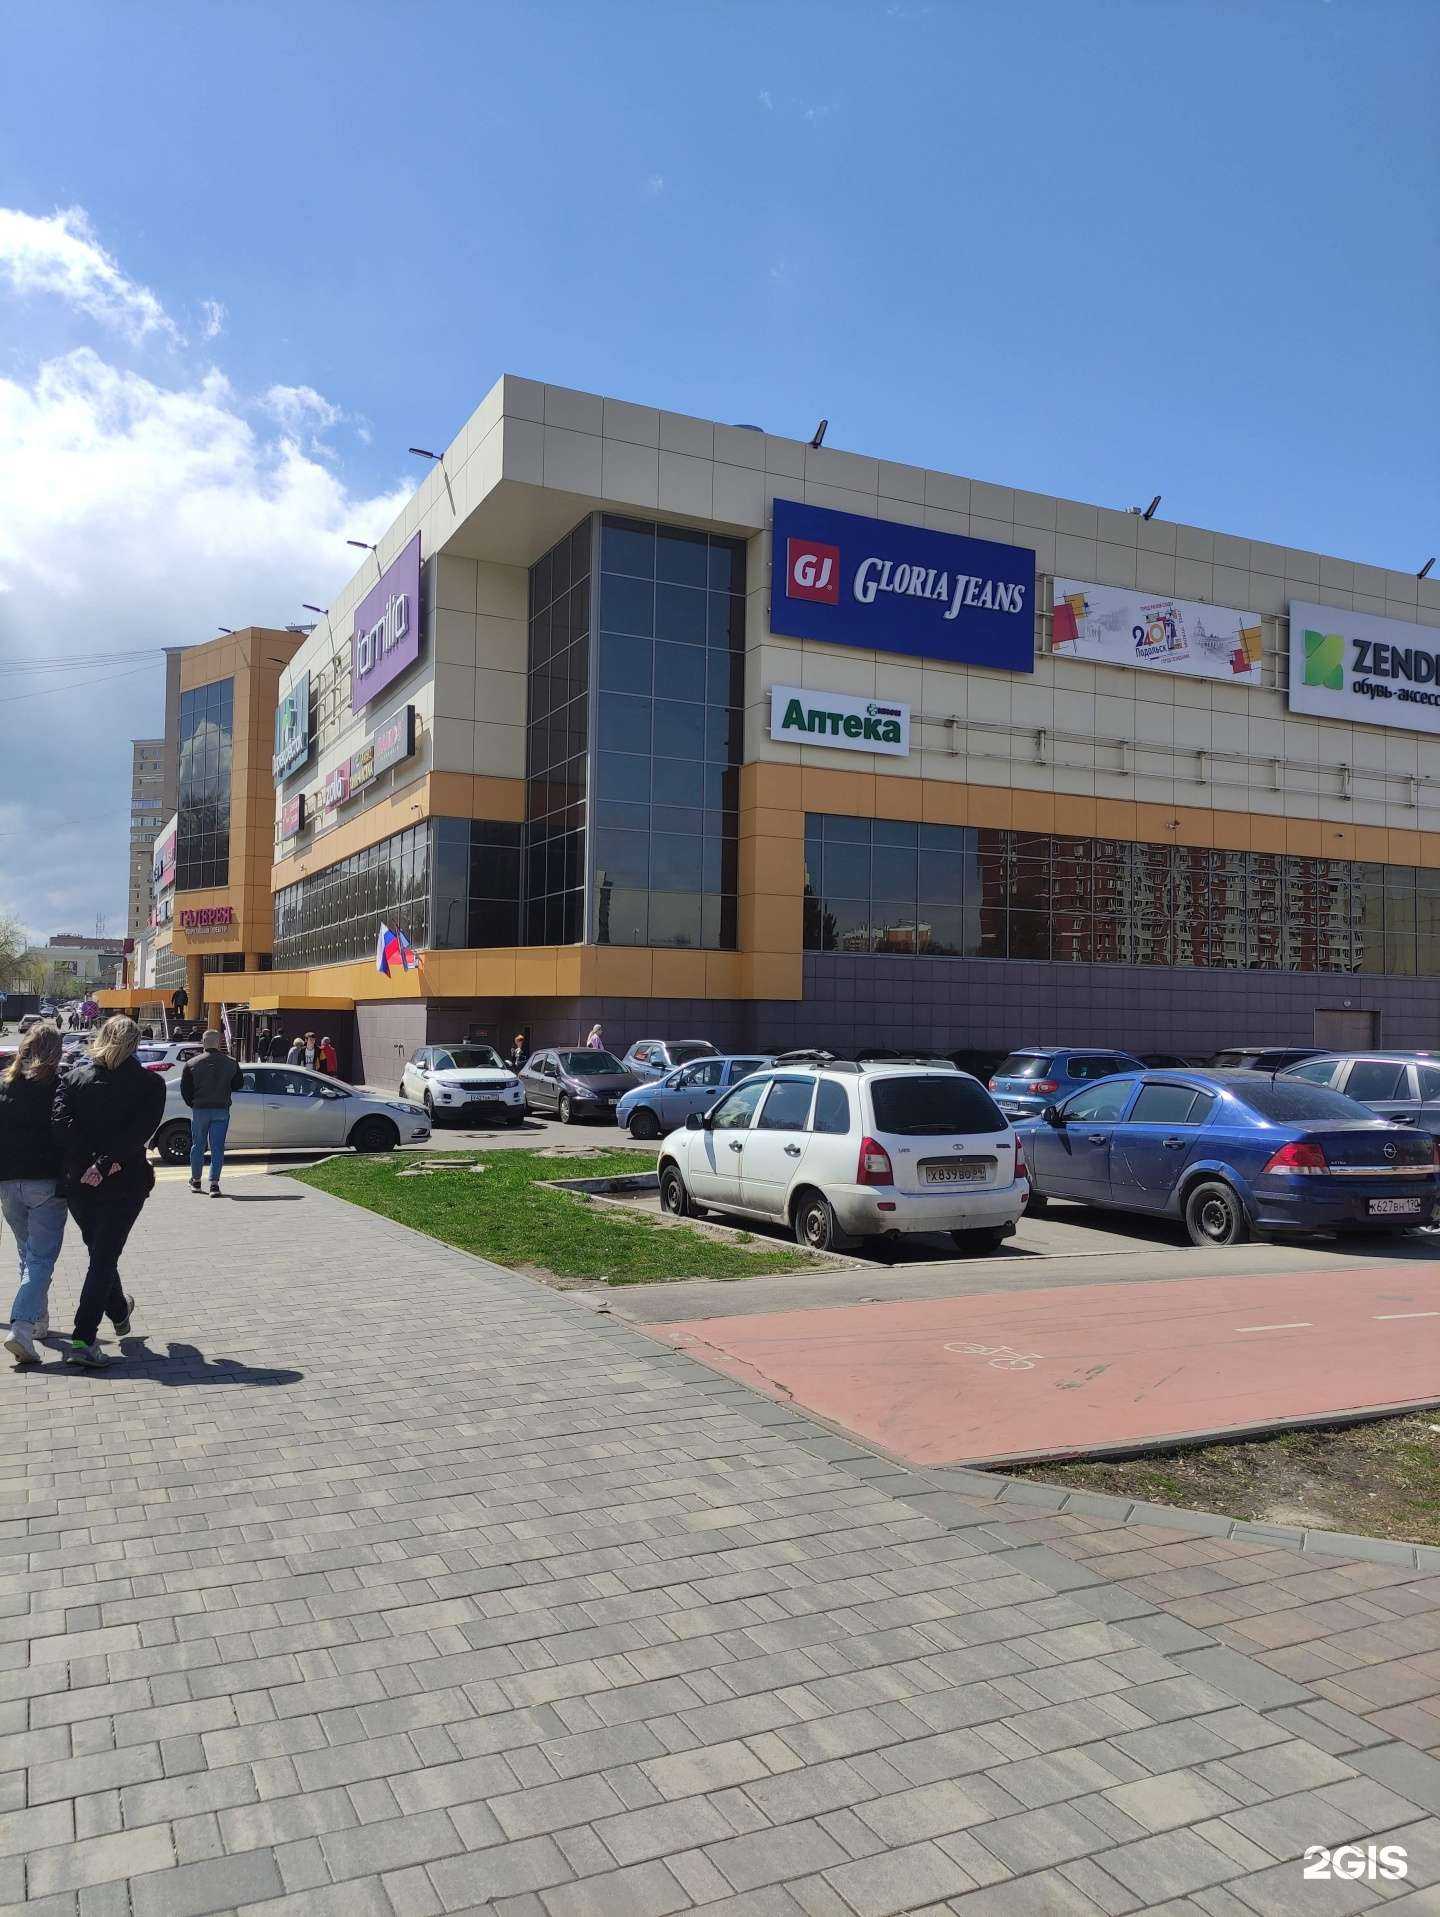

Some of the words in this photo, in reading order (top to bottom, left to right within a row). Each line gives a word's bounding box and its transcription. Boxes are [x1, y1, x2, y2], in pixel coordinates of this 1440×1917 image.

[853, 557, 948, 604] GLORIA
[943, 574, 1026, 619] JEANS
[1352, 638, 1440, 687] ZEND
[781, 698, 902, 744] Аптека
